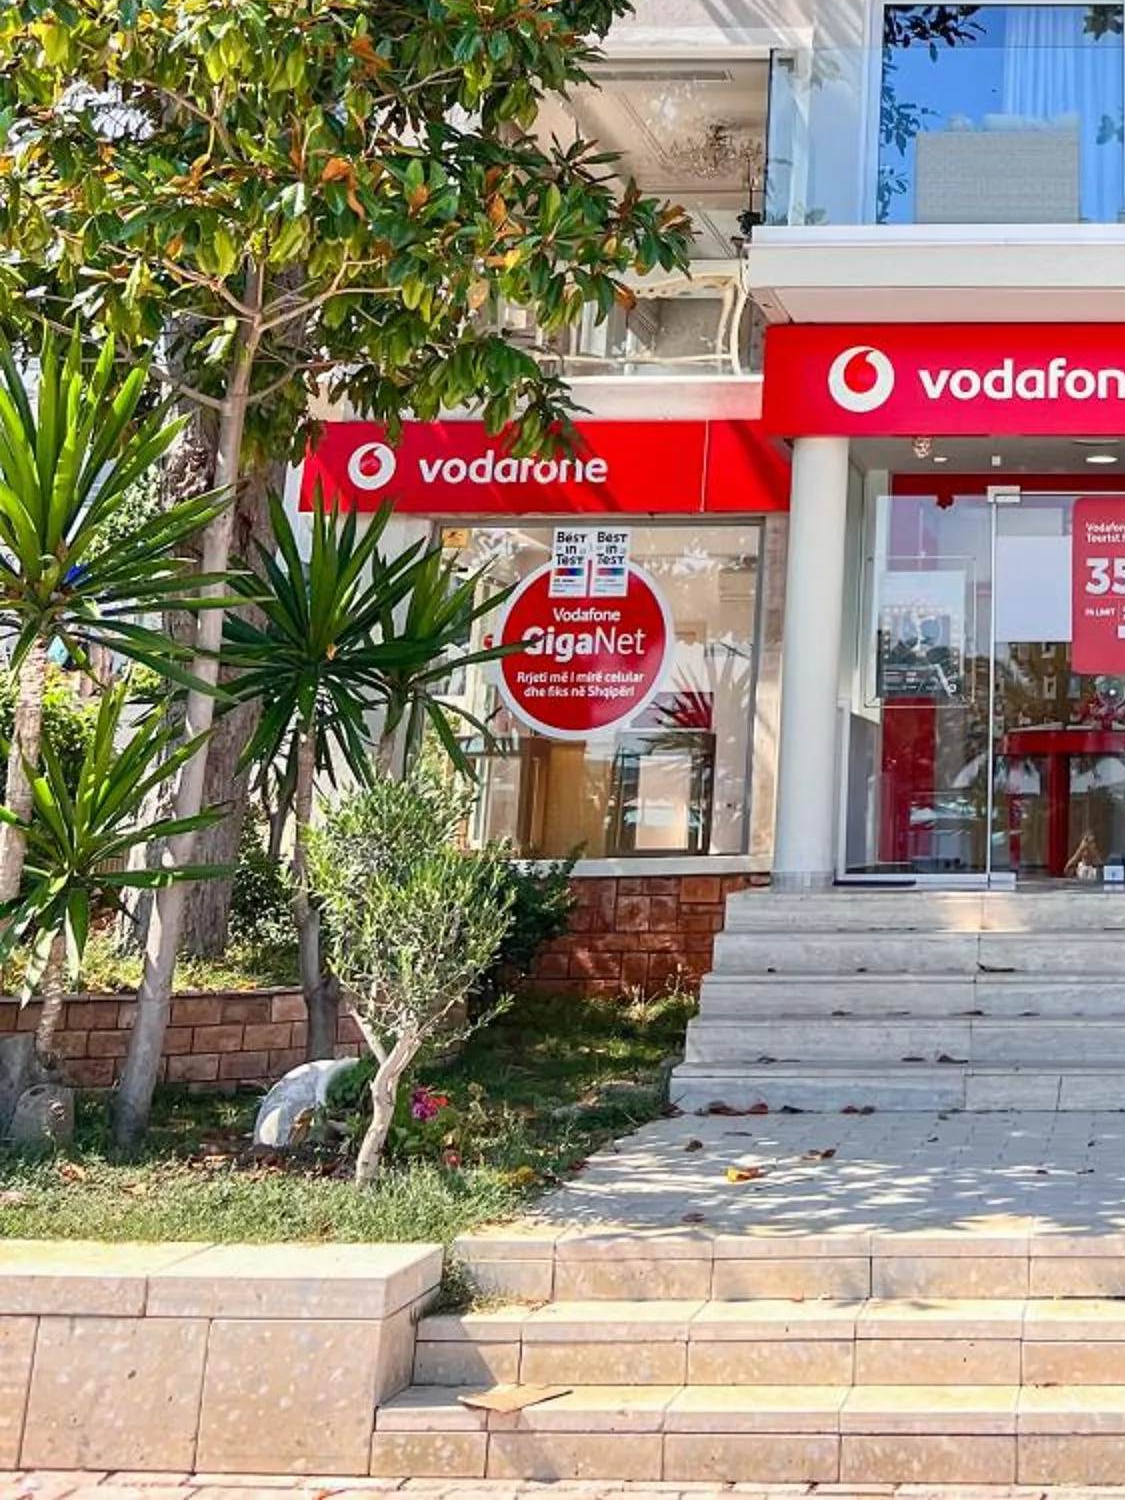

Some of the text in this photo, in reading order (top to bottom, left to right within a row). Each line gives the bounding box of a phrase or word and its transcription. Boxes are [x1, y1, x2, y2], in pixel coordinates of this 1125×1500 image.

[1086, 533, 1121, 544] Tourist
[552, 606, 622, 622] Vodafone
[521, 625, 647, 663] GigaNet
[516, 670, 548, 684] Rrjeti
[604, 670, 645, 683] celular
[523, 686, 546, 697] dhe
